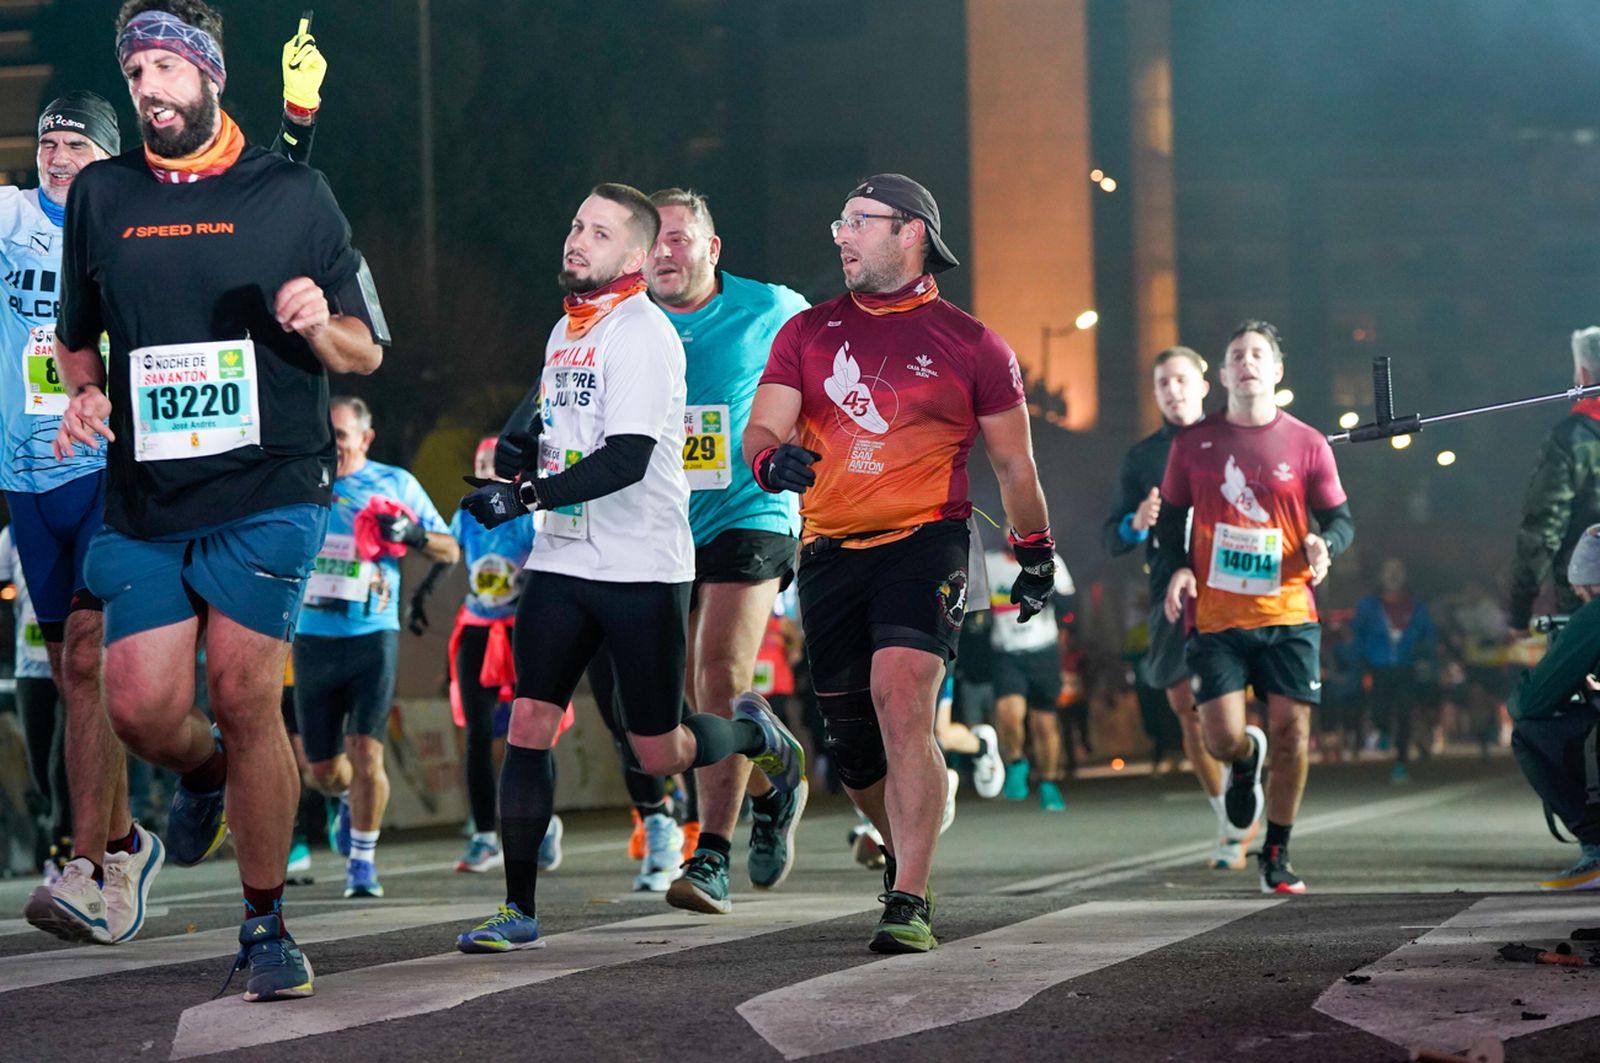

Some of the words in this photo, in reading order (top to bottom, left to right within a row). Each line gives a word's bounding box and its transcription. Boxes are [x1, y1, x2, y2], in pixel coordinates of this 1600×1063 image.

[136, 224, 193, 238] SPEED
[196, 223, 235, 234] RUN
[155, 357, 190, 370] NOCHE
[192, 356, 207, 367] DE
[144, 373, 165, 386] SAN
[147, 382, 241, 421] 13220
[842, 390, 870, 417] 43
[171, 421, 189, 430] José
[682, 435, 716, 462] 29
[851, 450, 873, 460] SAN
[1223, 549, 1272, 573] 14014
